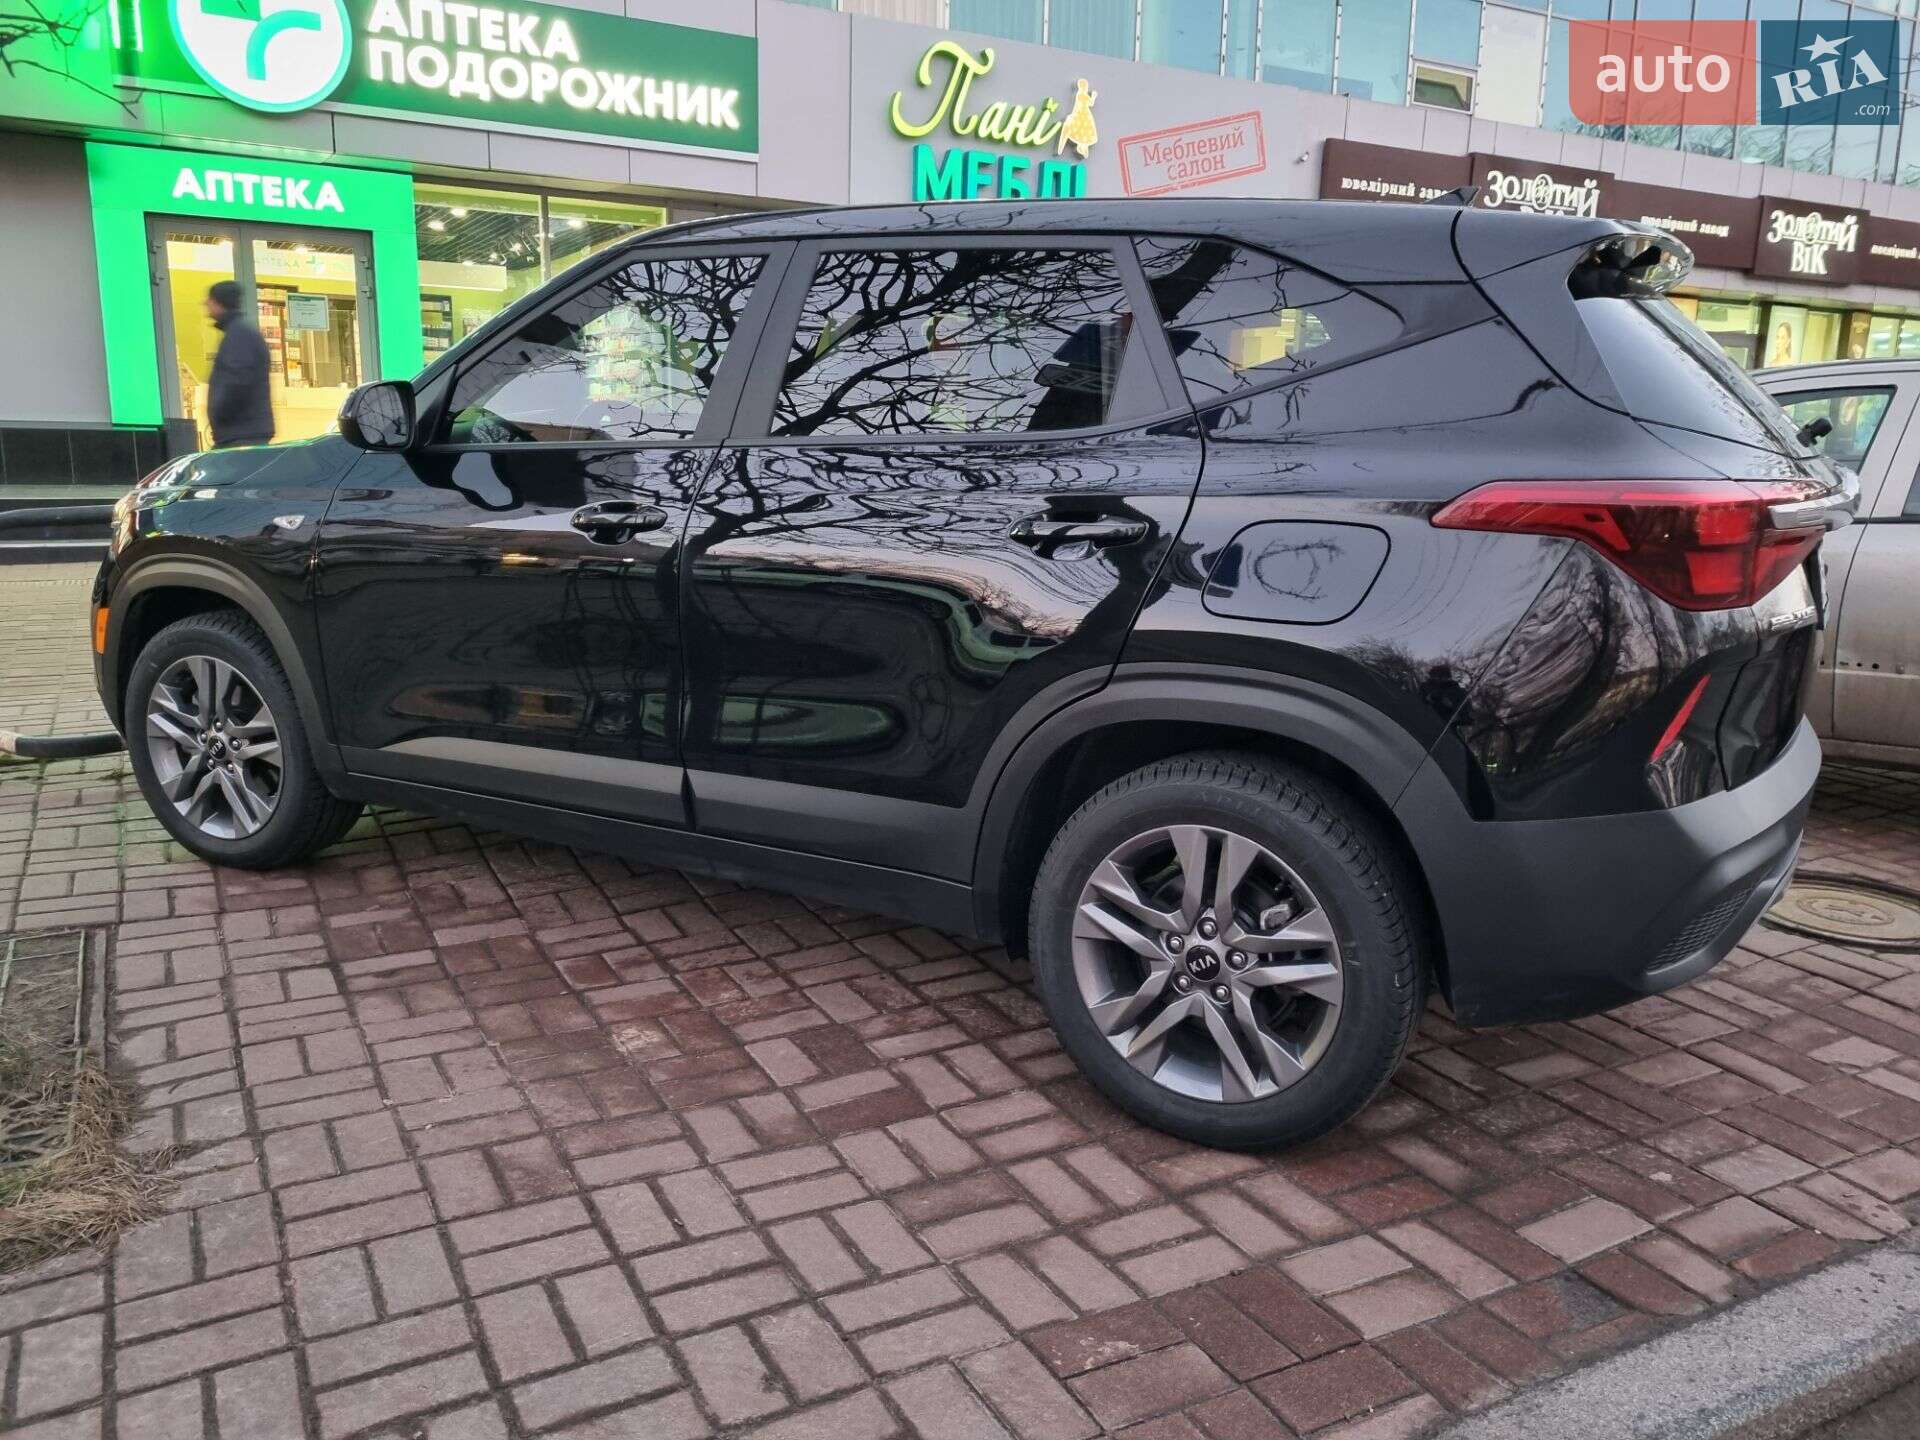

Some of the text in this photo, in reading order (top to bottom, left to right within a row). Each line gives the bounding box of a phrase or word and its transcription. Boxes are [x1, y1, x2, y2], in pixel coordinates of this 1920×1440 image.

[367, 0, 579, 62] АПТЕКА
[368, 37, 740, 129] ПОДОРОЖНИК
[889, 40, 1063, 146] Пані
[1141, 126, 1245, 167] Меблевий
[1167, 154, 1226, 180] салон
[172, 167, 345, 213] АПТЕКА
[1189, 954, 1217, 973] KIA
